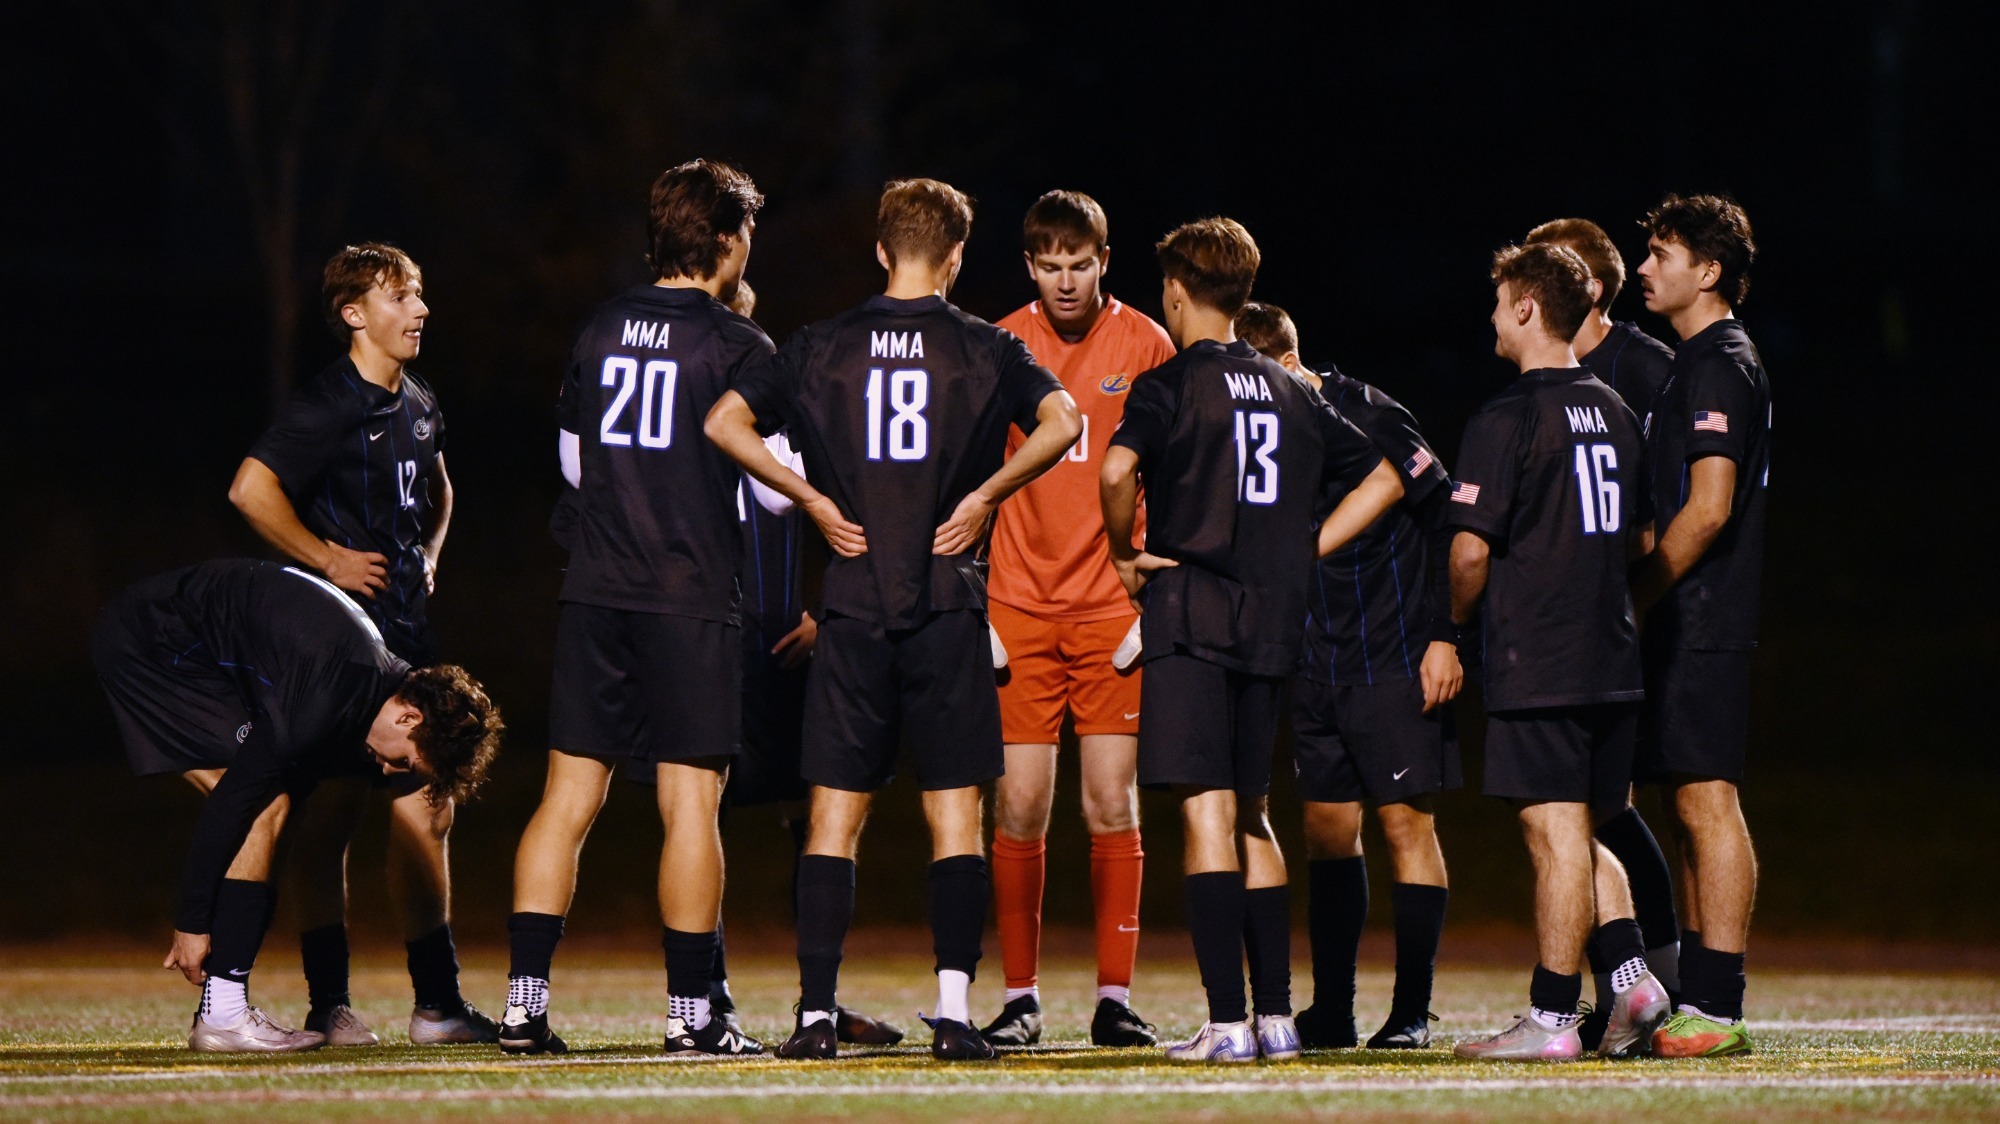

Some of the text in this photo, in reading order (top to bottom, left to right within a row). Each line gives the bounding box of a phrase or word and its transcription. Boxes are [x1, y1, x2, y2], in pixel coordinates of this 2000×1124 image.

[621, 319, 670, 350] MMA
[870, 330, 924, 359] MMA
[600, 354, 680, 451] 20
[1224, 372, 1274, 402] MMA
[864, 366, 930, 462] 18
[1564, 406, 1609, 434] MMA
[1233, 408, 1281, 506] 13
[397, 460, 417, 506] 12
[1573, 442, 1622, 535] 16
